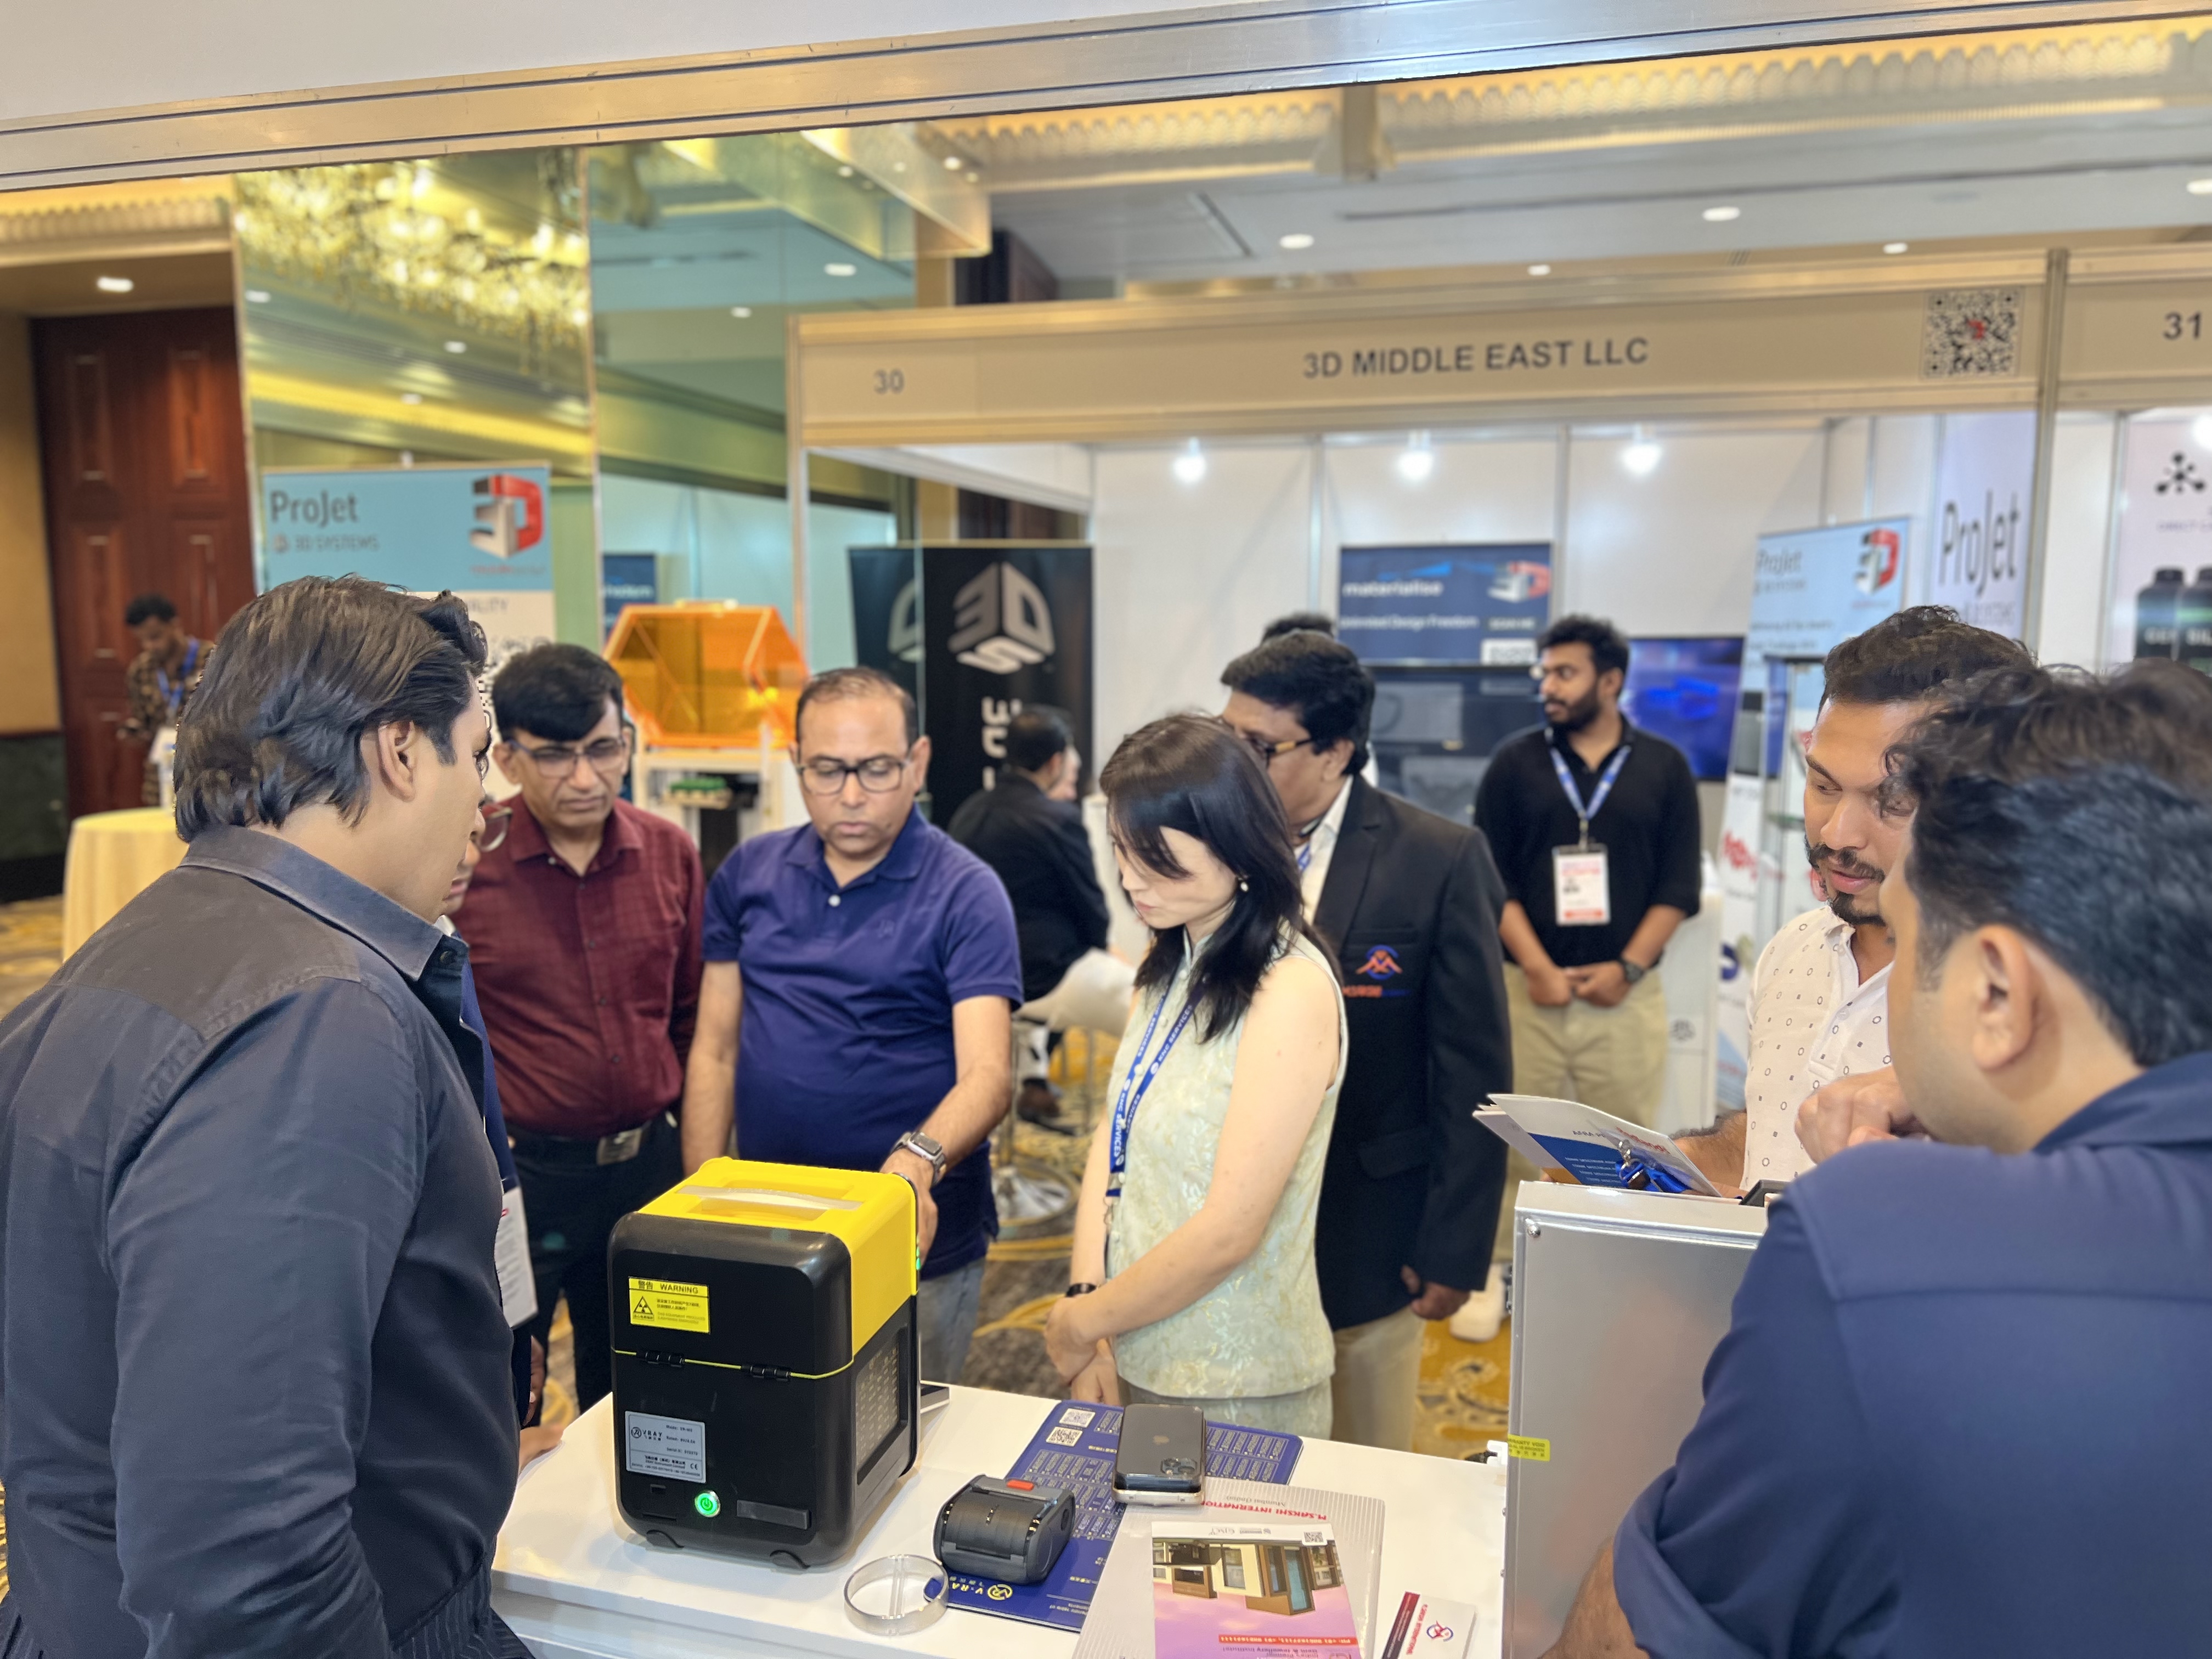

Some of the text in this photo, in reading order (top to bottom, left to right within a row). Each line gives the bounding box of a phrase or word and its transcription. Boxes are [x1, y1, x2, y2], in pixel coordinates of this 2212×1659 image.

[2164, 311, 2203, 340] 31
[1303, 337, 1648, 379] 3D MIDDLE EAST LLC
[872, 368, 905, 395] 30
[270, 489, 359, 529] ProJet
[1938, 488, 2020, 598] ProJet
[660, 1283, 698, 1295] WARNING
[1276, 1509, 1327, 1521] M.SAKSHI
